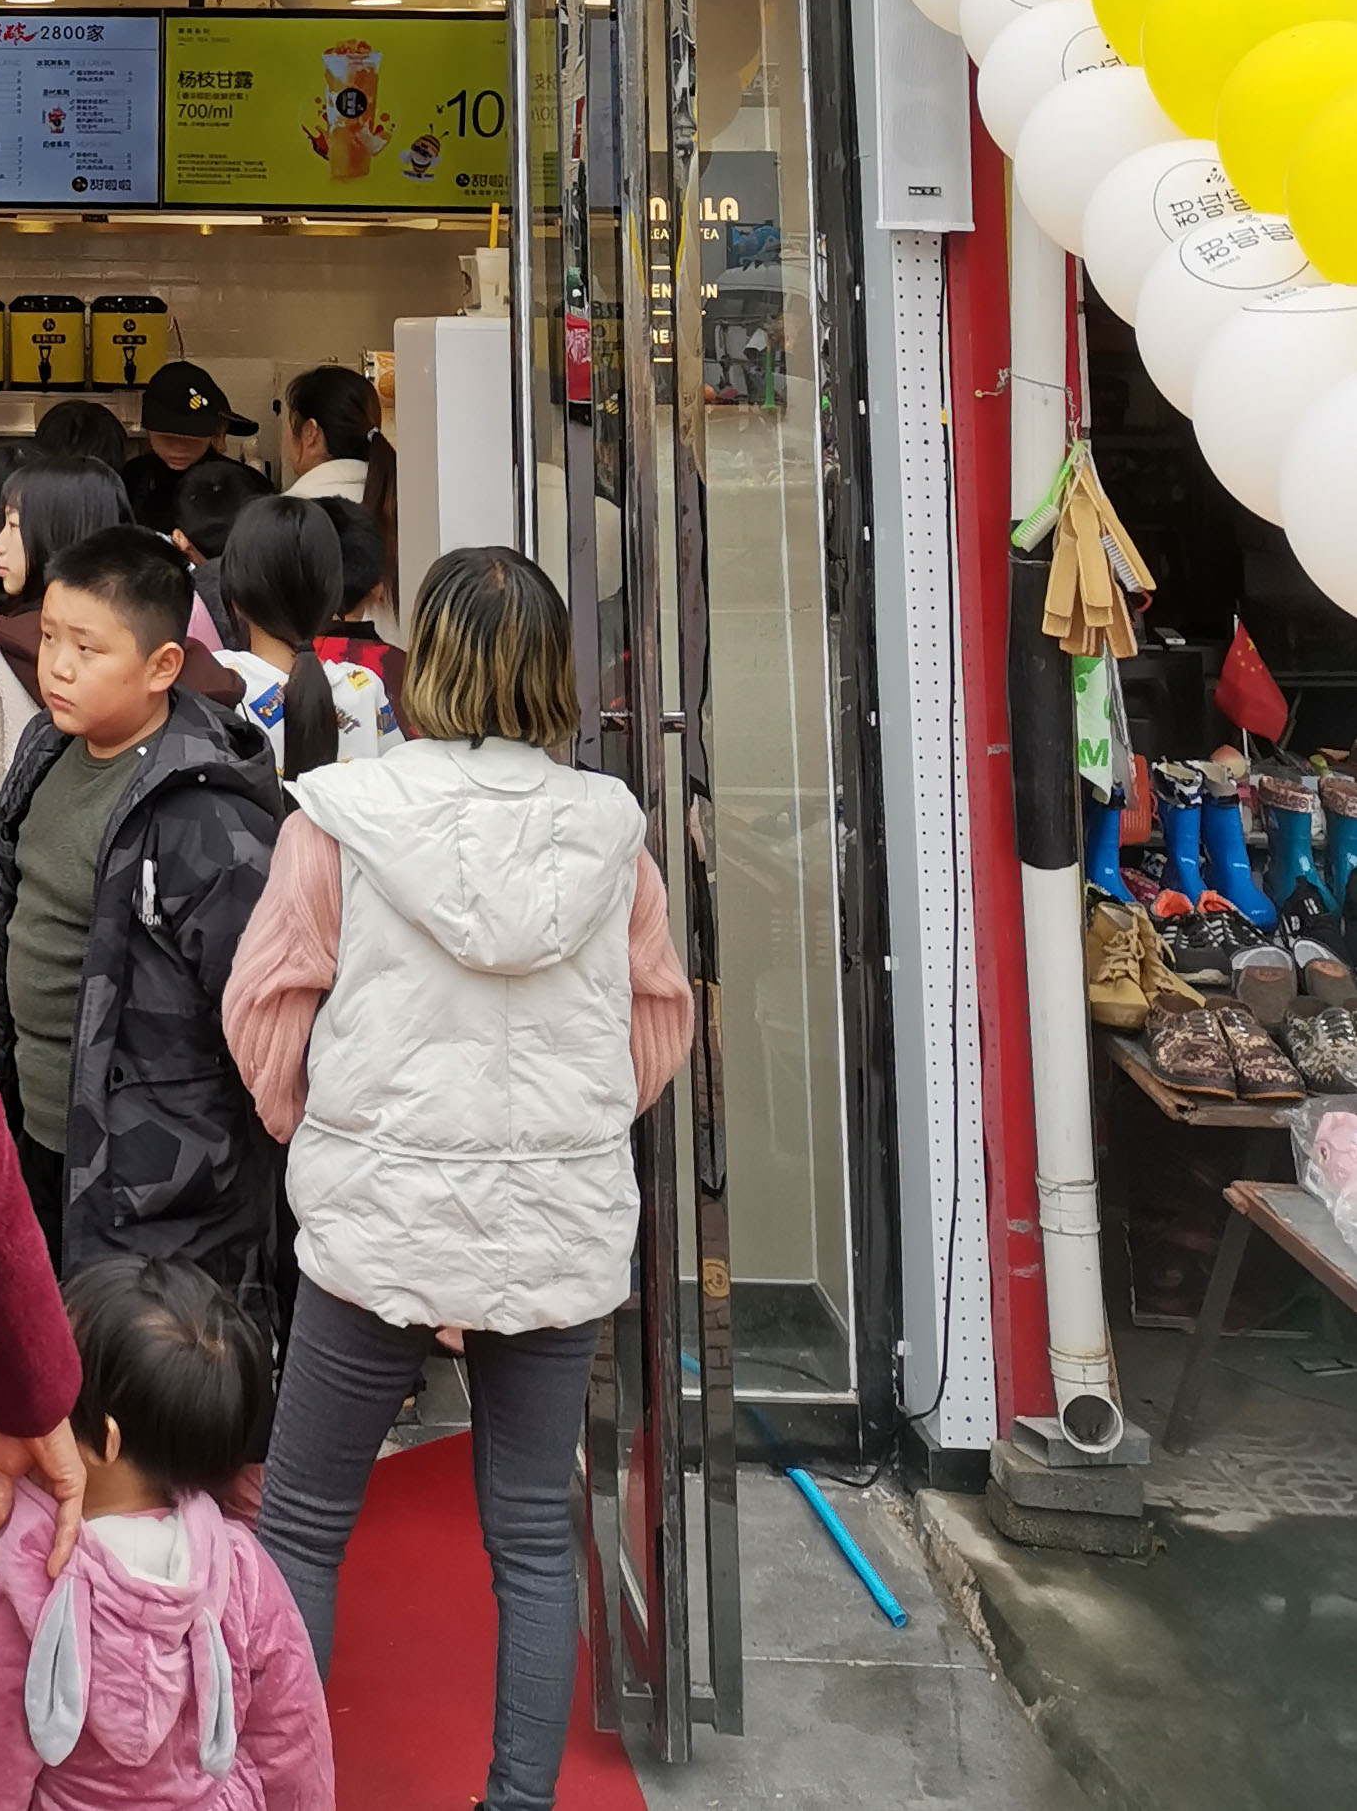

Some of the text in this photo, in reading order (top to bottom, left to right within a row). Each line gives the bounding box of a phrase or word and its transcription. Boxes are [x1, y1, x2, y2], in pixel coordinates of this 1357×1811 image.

[177, 70, 254, 90] 杨枝甘露
[177, 104, 233, 120] 700/ml
